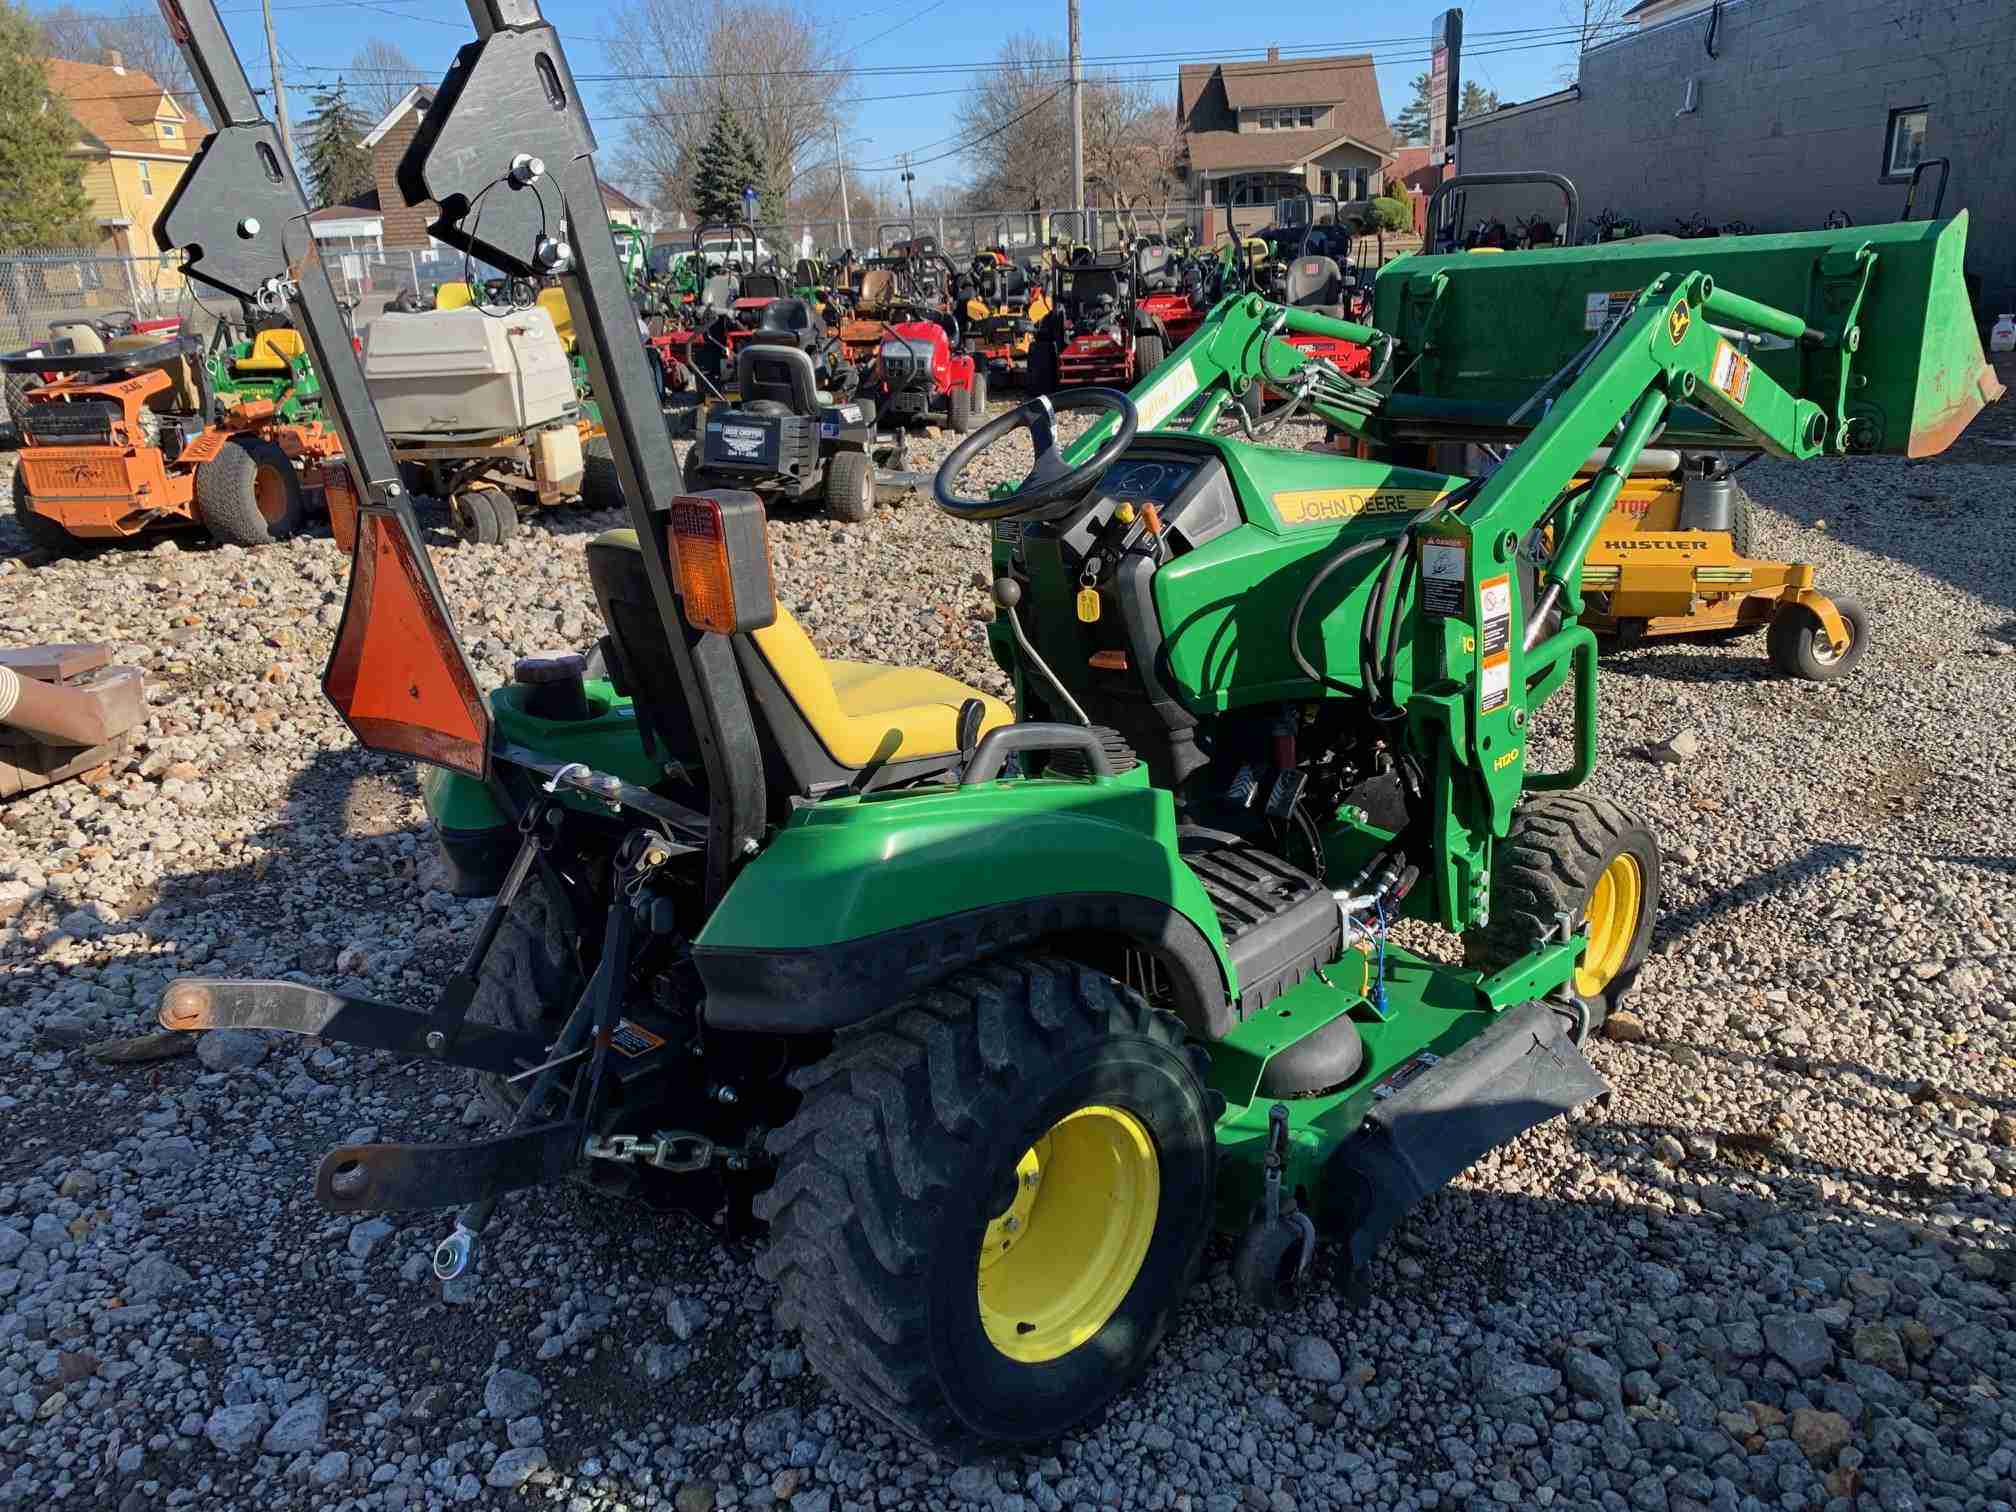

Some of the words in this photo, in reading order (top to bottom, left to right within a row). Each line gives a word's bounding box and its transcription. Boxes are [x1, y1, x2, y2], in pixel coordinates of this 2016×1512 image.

[1297, 496, 1346, 520] JOHN
[1347, 495, 1408, 514] DEERE
[1604, 540, 1709, 550] HUSTLER
